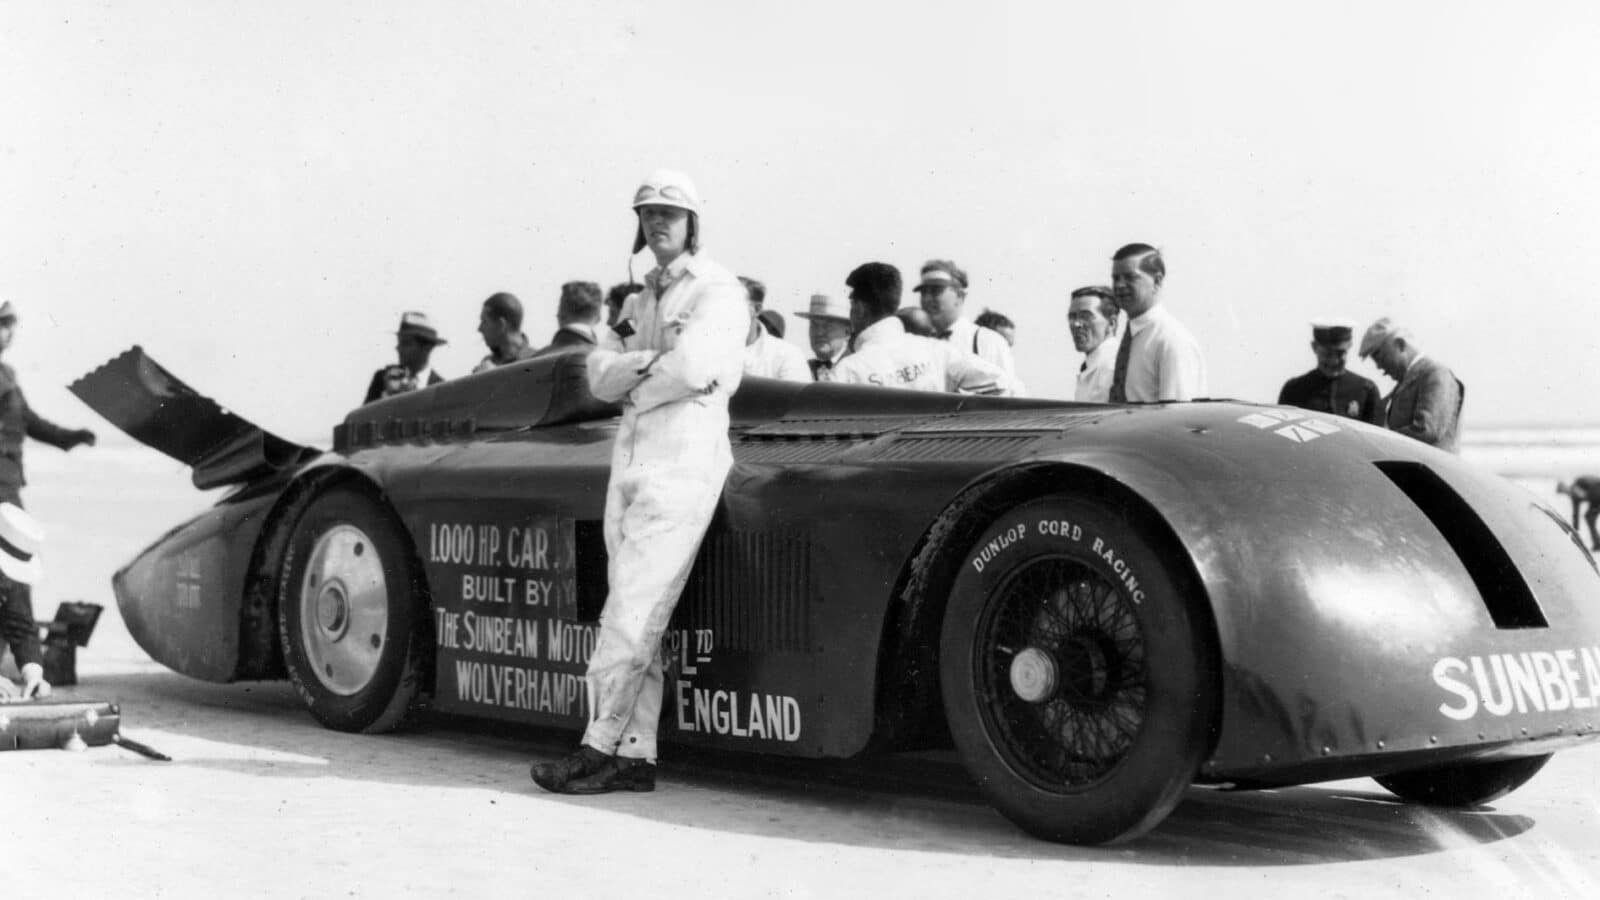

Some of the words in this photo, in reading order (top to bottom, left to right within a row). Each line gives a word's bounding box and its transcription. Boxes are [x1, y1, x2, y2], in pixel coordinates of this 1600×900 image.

[972, 523, 1026, 573] DUNLOP
[1038, 520, 1082, 541] CORD
[462, 574, 516, 604] BUILT
[525, 579, 552, 607] BY
[437, 607, 460, 649] THE
[463, 610, 538, 659] SUNBEAM
[456, 660, 588, 718] WOLVERHAMPT
[677, 679, 801, 742] ENGLAND
[1433, 646, 1600, 720] SUNBEA
